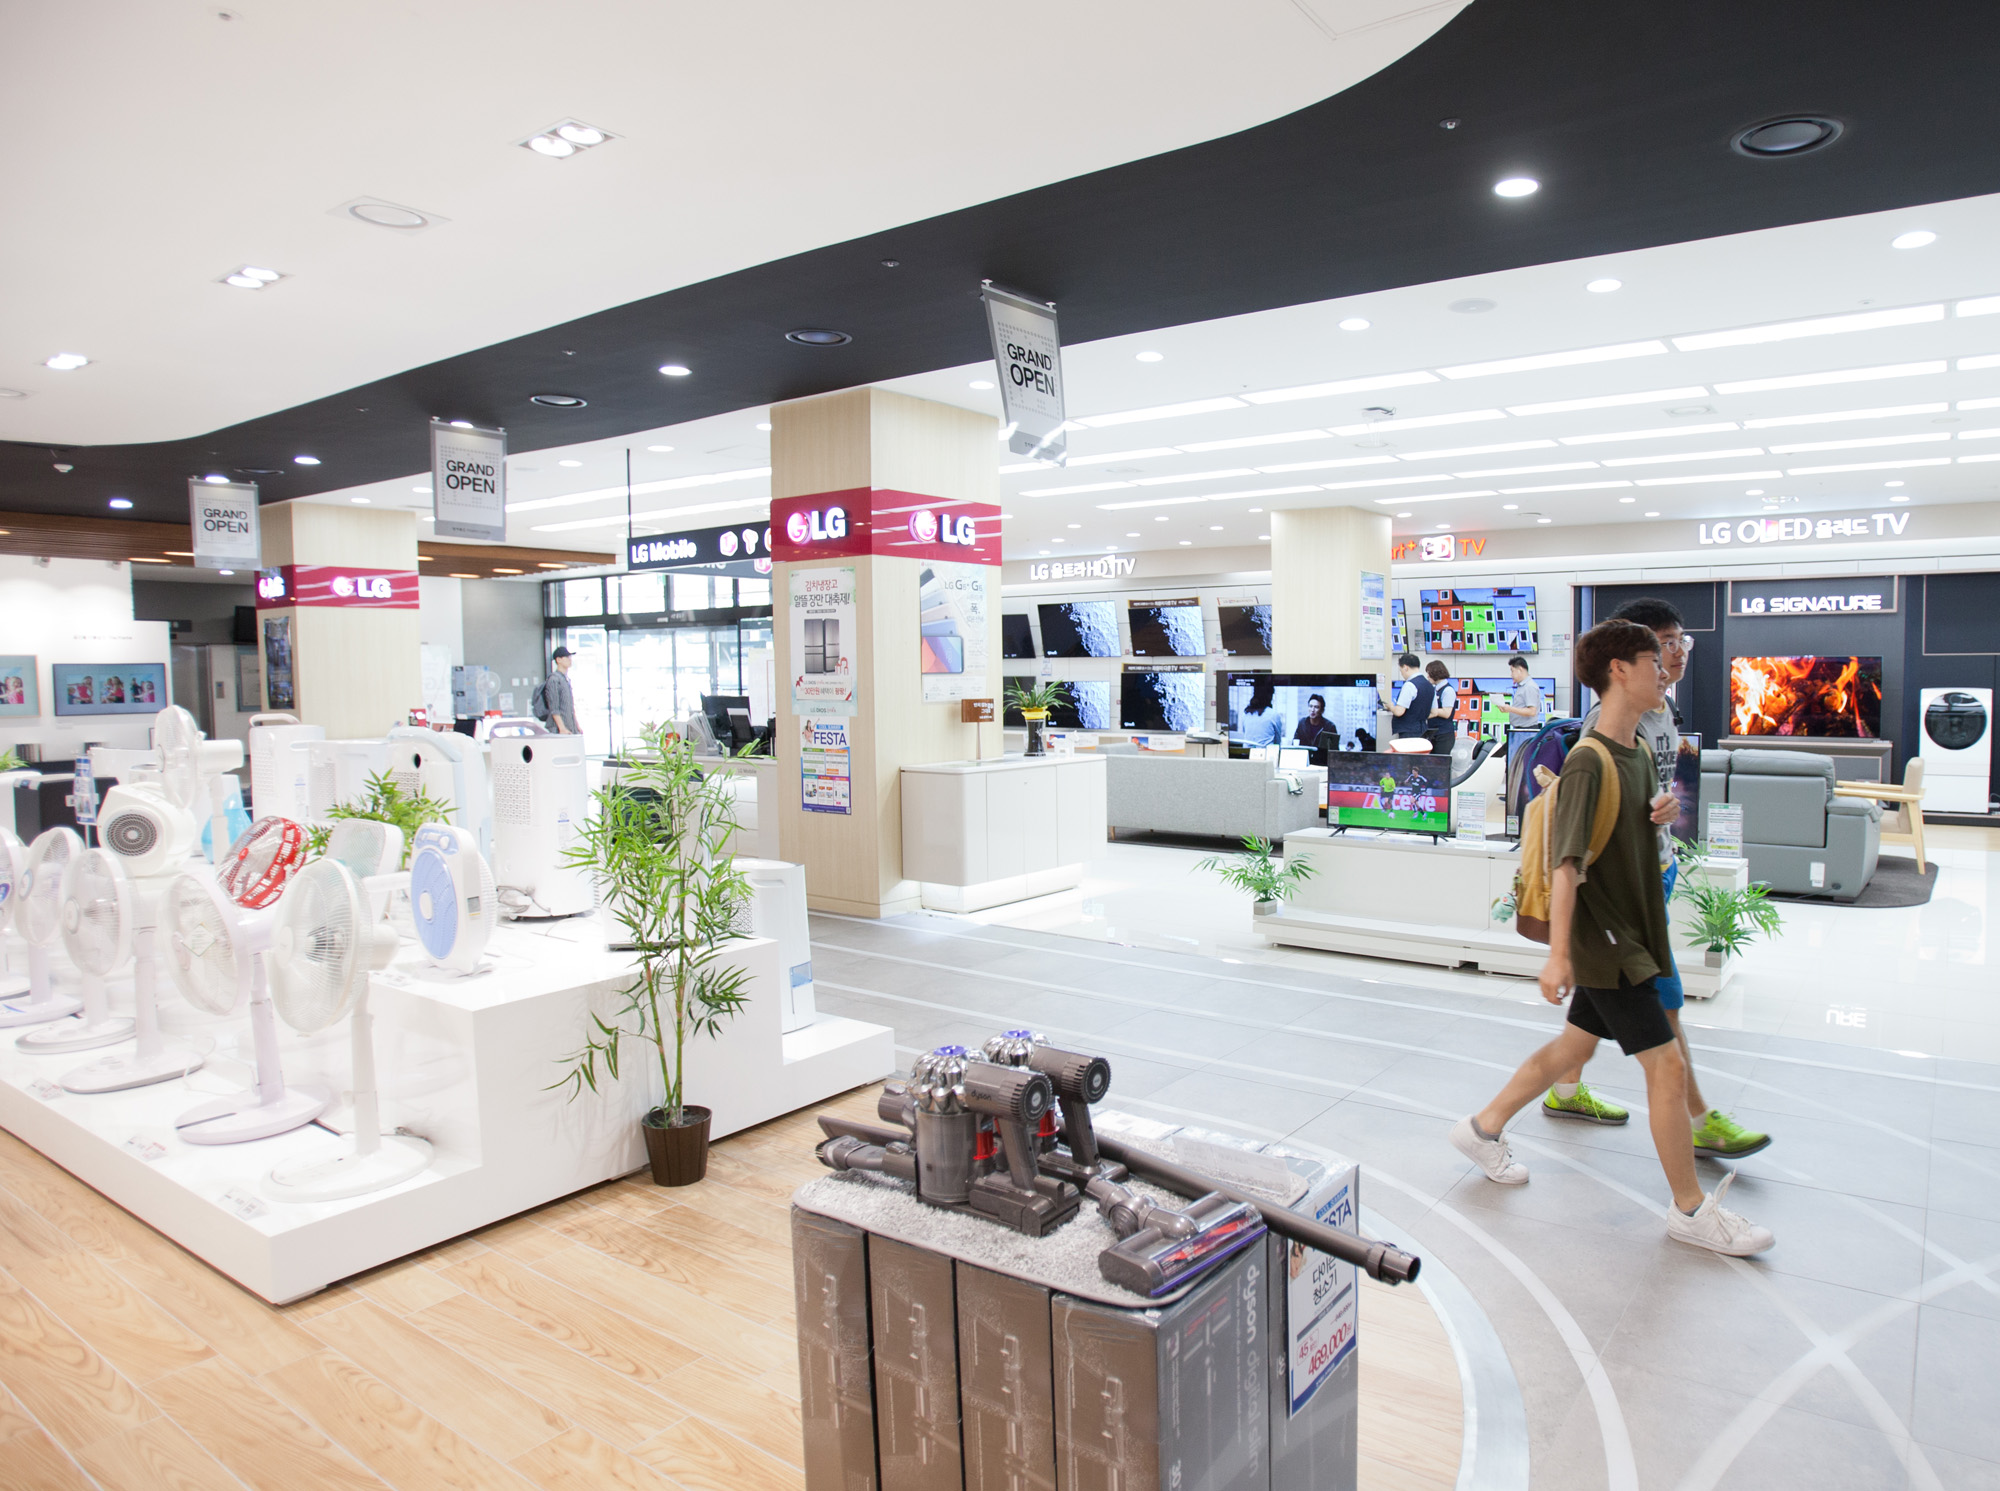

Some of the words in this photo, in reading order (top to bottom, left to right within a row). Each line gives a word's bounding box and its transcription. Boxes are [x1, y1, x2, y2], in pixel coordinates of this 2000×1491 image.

[1007, 343, 1052, 371] GRAND
[1010, 364, 1055, 397] OPEN
[446, 460, 495, 477] GRAND
[446, 474, 495, 494] OPEN
[203, 508, 248, 520] GRAND
[811, 507, 847, 540] LG
[203, 519, 249, 533] OPEN
[941, 513, 976, 546] LG
[1700, 522, 1732, 545] LG
[1736, 518, 1813, 543] OLED
[1871, 512, 1910, 536] TV
[631, 545, 649, 564] LG
[650, 539, 697, 561] Mobile
[1458, 538, 1486, 556] TV
[1030, 564, 1049, 580] LG
[357, 577, 392, 598] LG
[1741, 598, 1766, 613] LG
[1770, 594, 1882, 612] SIGNATURE
[813, 731, 848, 746] FESTA
[971, 1088, 992, 1101] dyson
[1243, 1264, 1261, 1344] dyson
[1244, 1350, 1261, 1422] digital
[1249, 1425, 1263, 1478] slim
